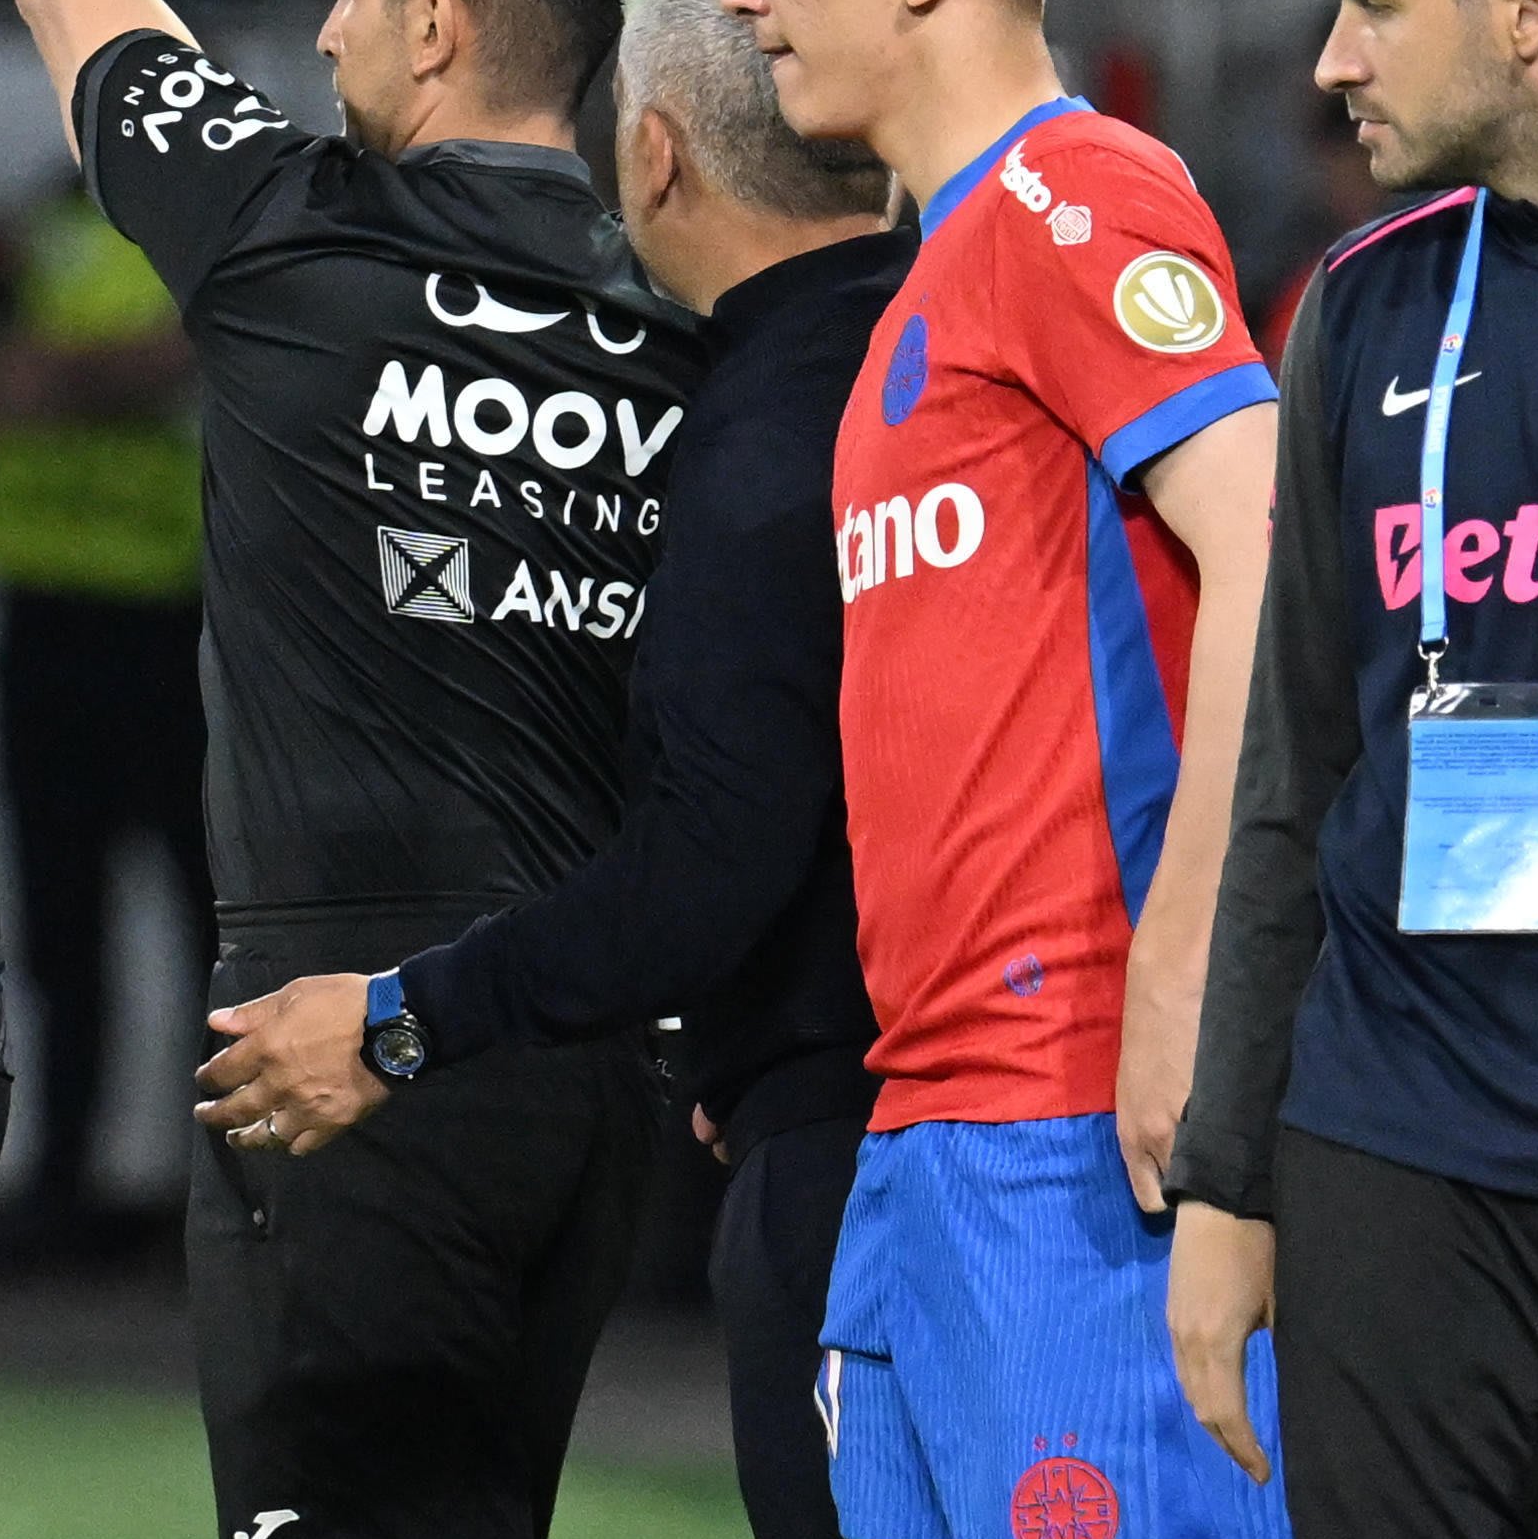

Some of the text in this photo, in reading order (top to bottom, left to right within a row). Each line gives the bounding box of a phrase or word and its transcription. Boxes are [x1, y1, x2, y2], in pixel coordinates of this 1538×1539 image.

[362, 359, 685, 478] MOOV
[364, 453, 662, 536] LEASING
[837, 481, 985, 604] tano
